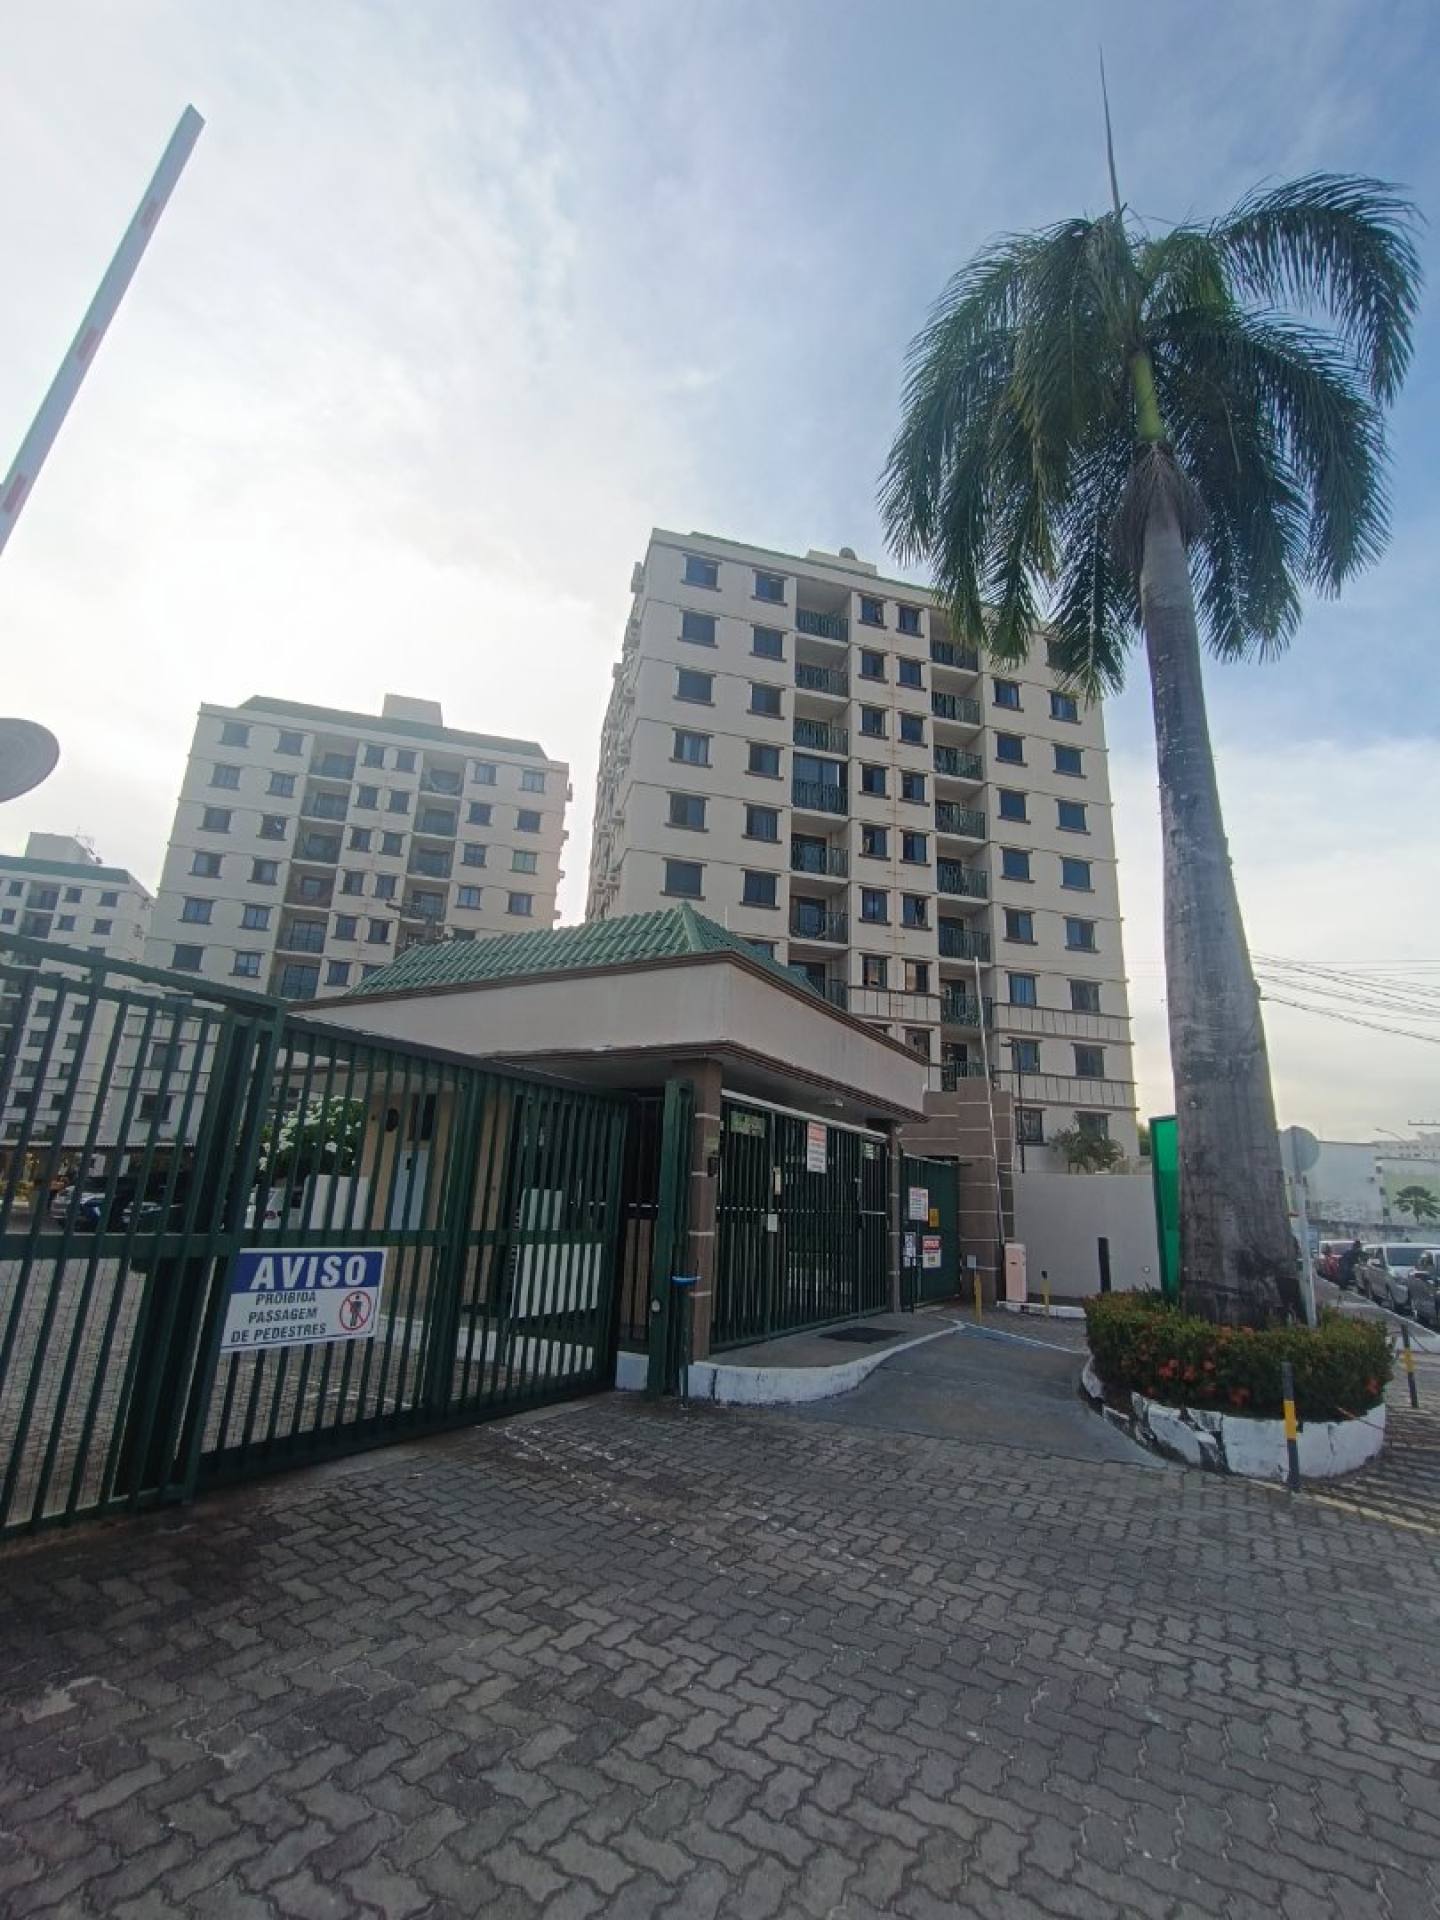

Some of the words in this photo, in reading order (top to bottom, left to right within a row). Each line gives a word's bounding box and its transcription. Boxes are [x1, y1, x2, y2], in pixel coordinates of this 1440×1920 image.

[250, 1255, 367, 1290] AVISO
[255, 1291, 316, 1306] PROIBIDA
[248, 1307, 318, 1324] PASSAGEM
[231, 1330, 249, 1343] DE
[254, 1323, 326, 1341] PEDESTRES
